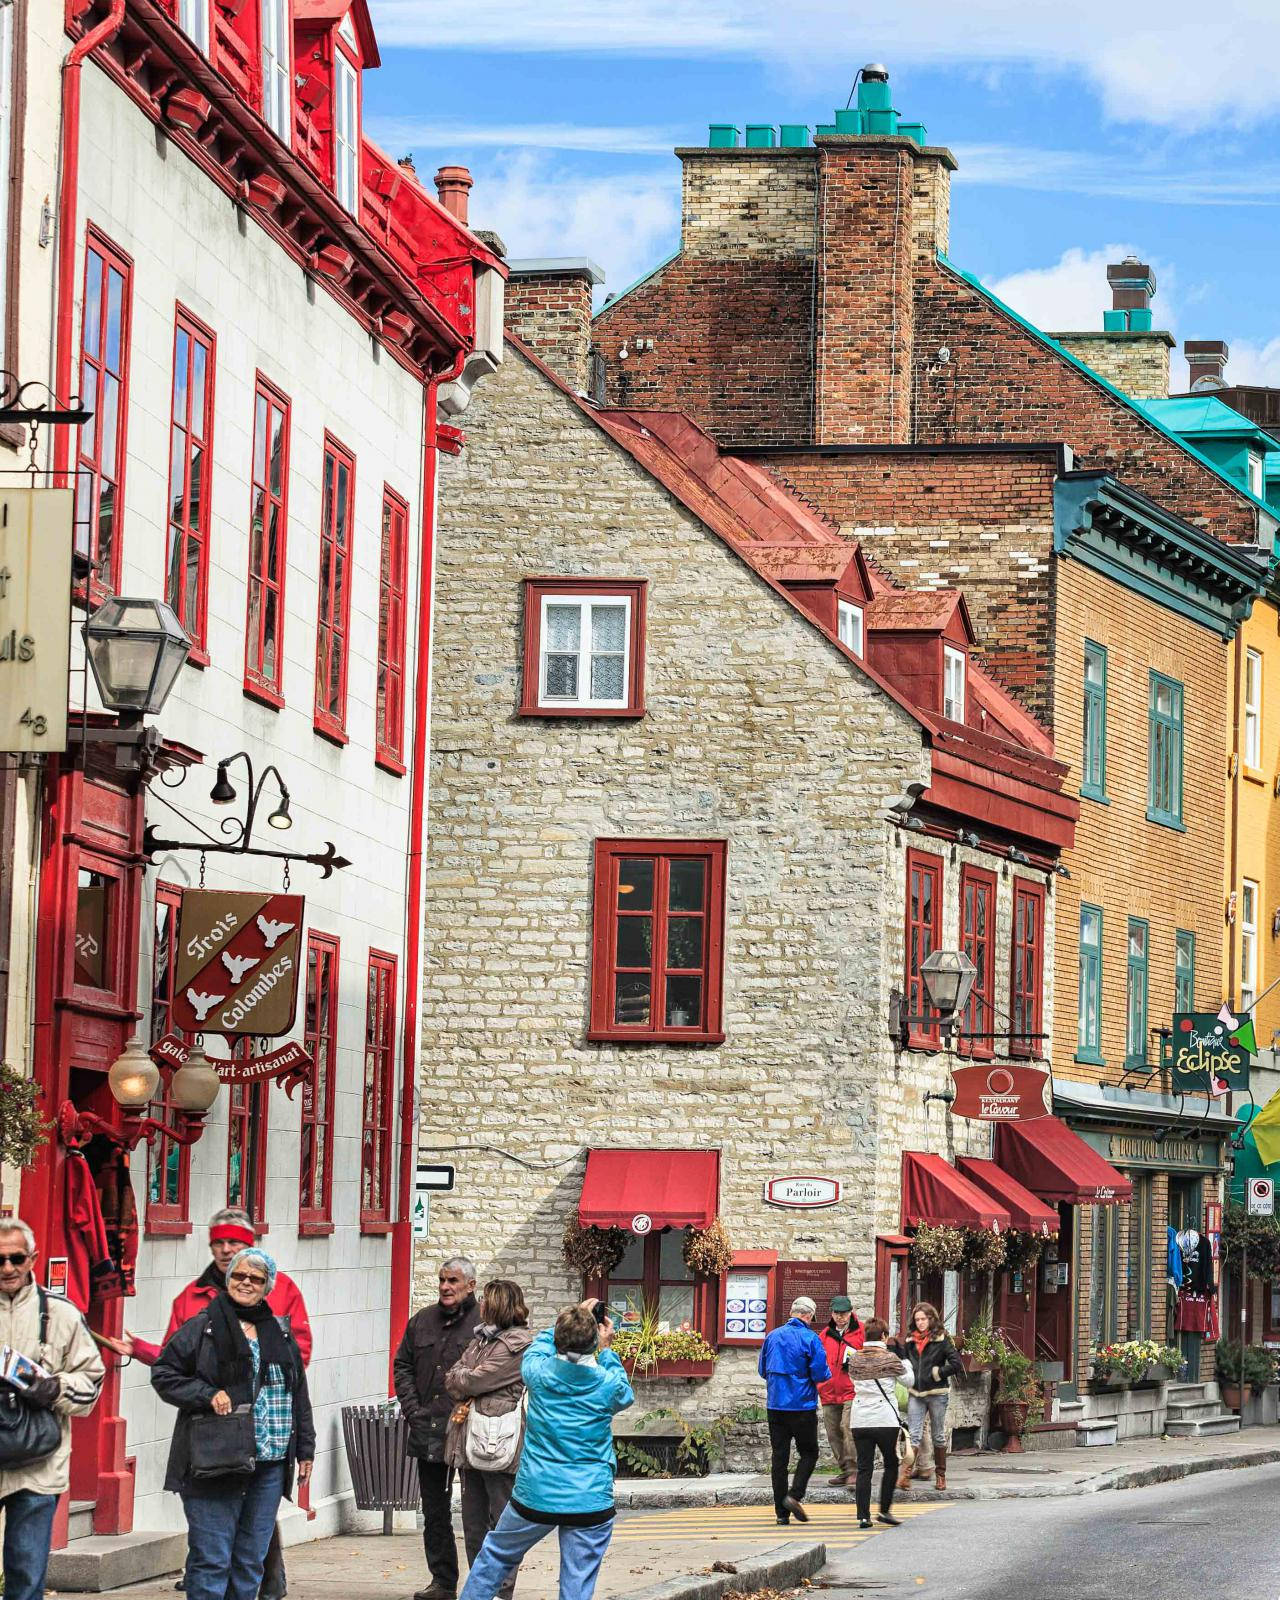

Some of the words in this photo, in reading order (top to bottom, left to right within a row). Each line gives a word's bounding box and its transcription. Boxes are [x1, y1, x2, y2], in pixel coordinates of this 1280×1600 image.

[19, 706, 48, 736] 48
[187, 912, 238, 961] Trois
[221, 955, 293, 1029] Colombes
[242, 1047, 301, 1077] artisanat
[1176, 1041, 1241, 1080] Eclipse
[989, 1102, 1019, 1115] Cavour
[786, 1187, 822, 1197] Parloir
